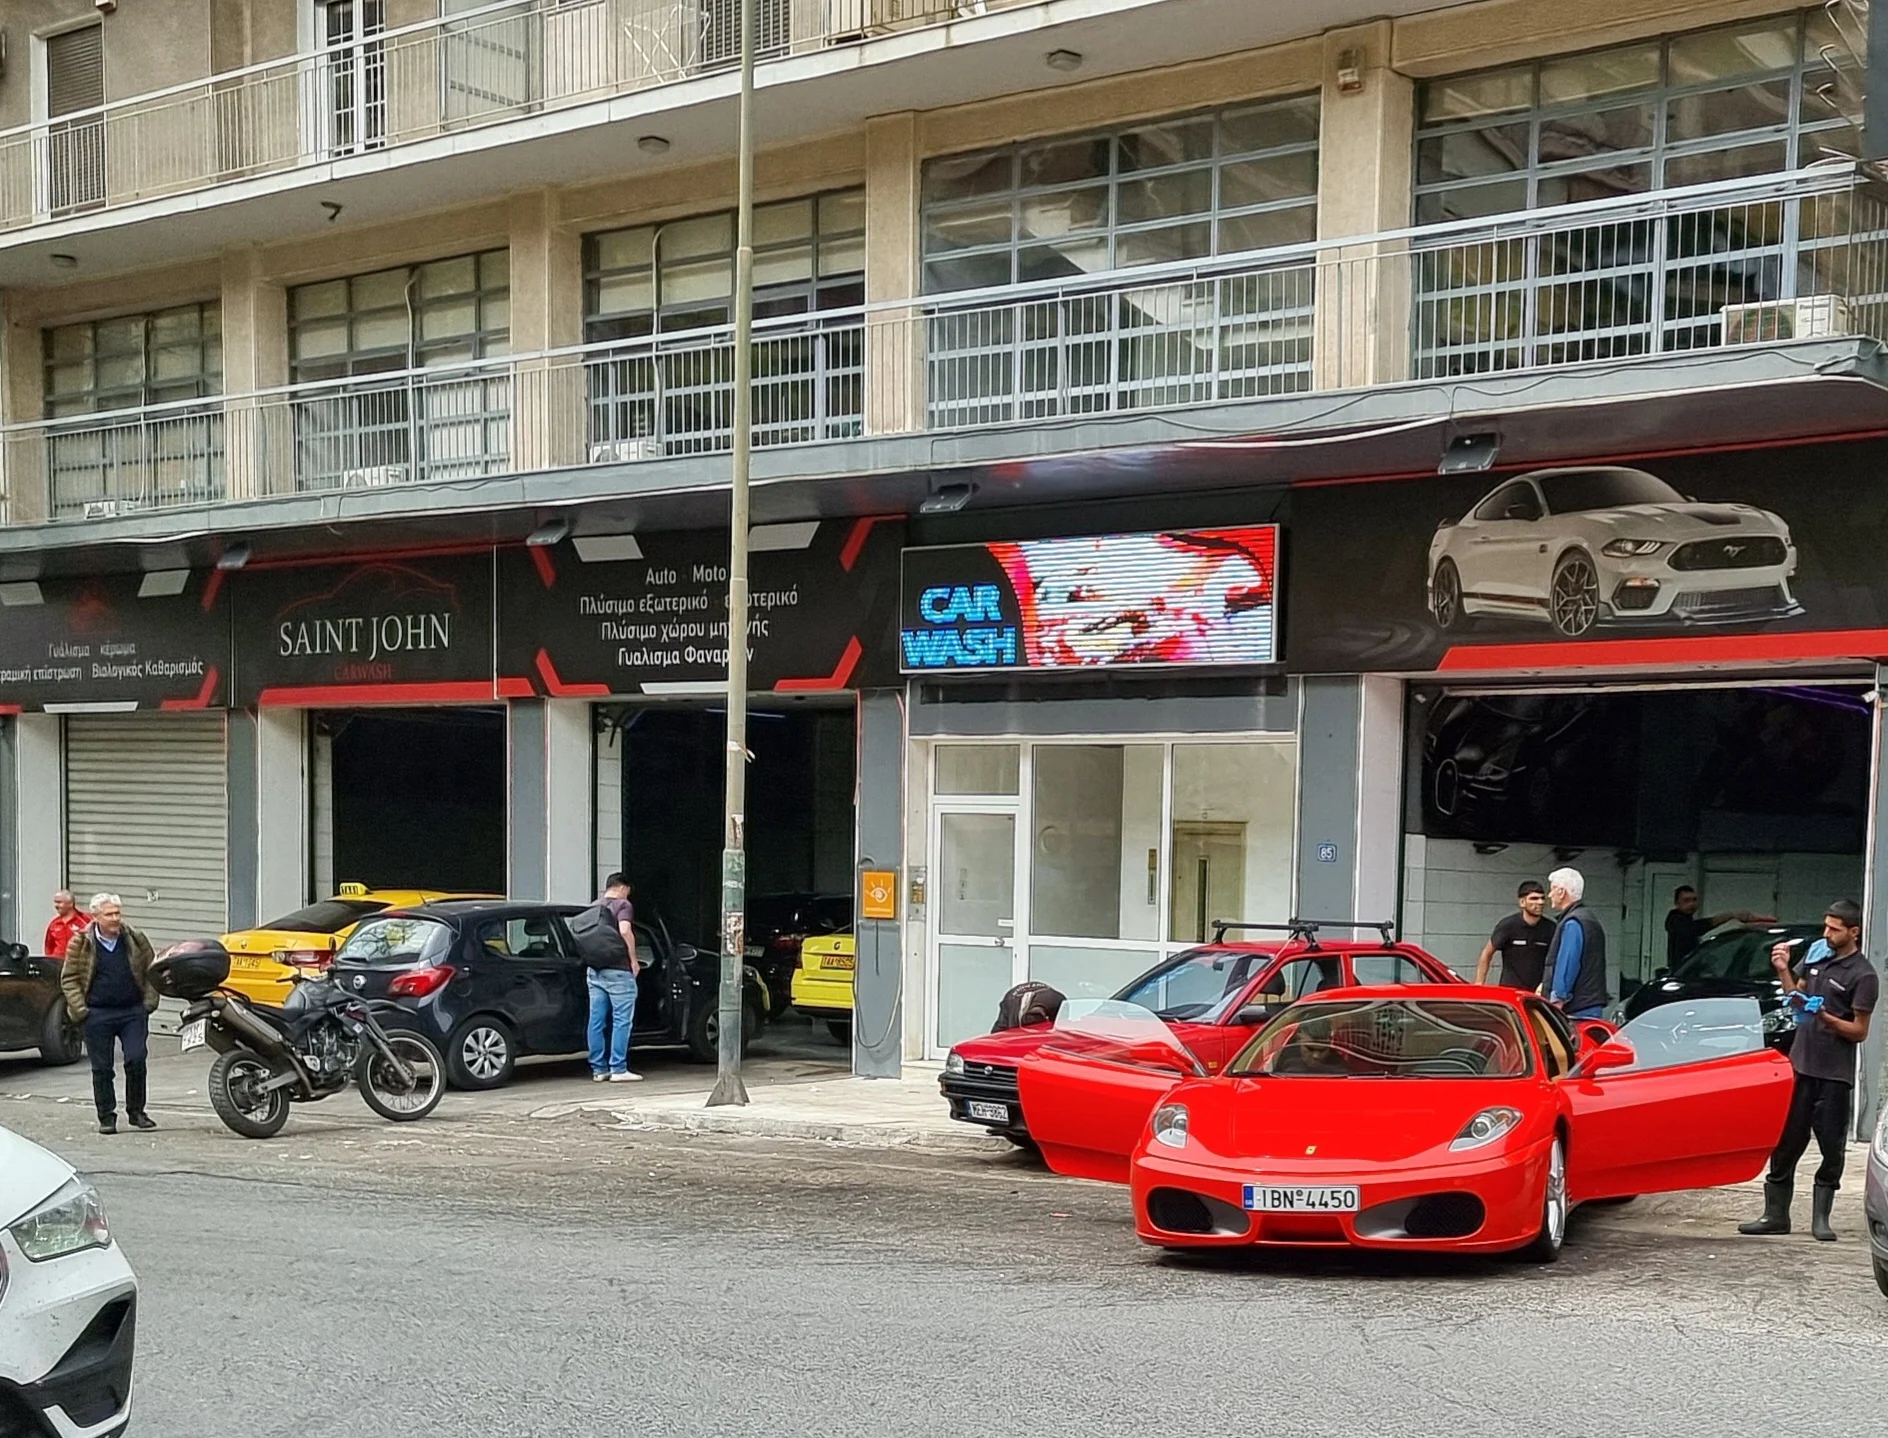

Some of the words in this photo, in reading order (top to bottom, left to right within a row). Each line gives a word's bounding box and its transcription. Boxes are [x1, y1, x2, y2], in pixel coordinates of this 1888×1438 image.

[645, 567, 677, 585] Auto
[692, 564, 726, 583] Moto
[580, 592, 635, 615] Πλύσιμο
[639, 589, 709, 614] εξωτερικό
[724, 583, 798, 611] ετερικό
[919, 584, 1003, 624] CAR
[280, 617, 363, 657] SAINT
[368, 612, 451, 662] JOHN
[601, 620, 657, 640] Πλύσιμο
[660, 617, 705, 643] χώρου
[709, 613, 769, 639] μηνής
[48, 641, 90, 658] Γυάλισμα
[618, 648, 681, 667] Γυαλισμα
[684, 645, 754, 667] Φαναρν
[901, 626, 1016, 667] WASH
[0, 665, 31, 682] ραμική
[92, 660, 143, 680] Βιολογικός
[145, 656, 204, 678] Καθαρισμός
[334, 663, 392, 681] CARWASH
[1320, 847, 1334, 859] 85
